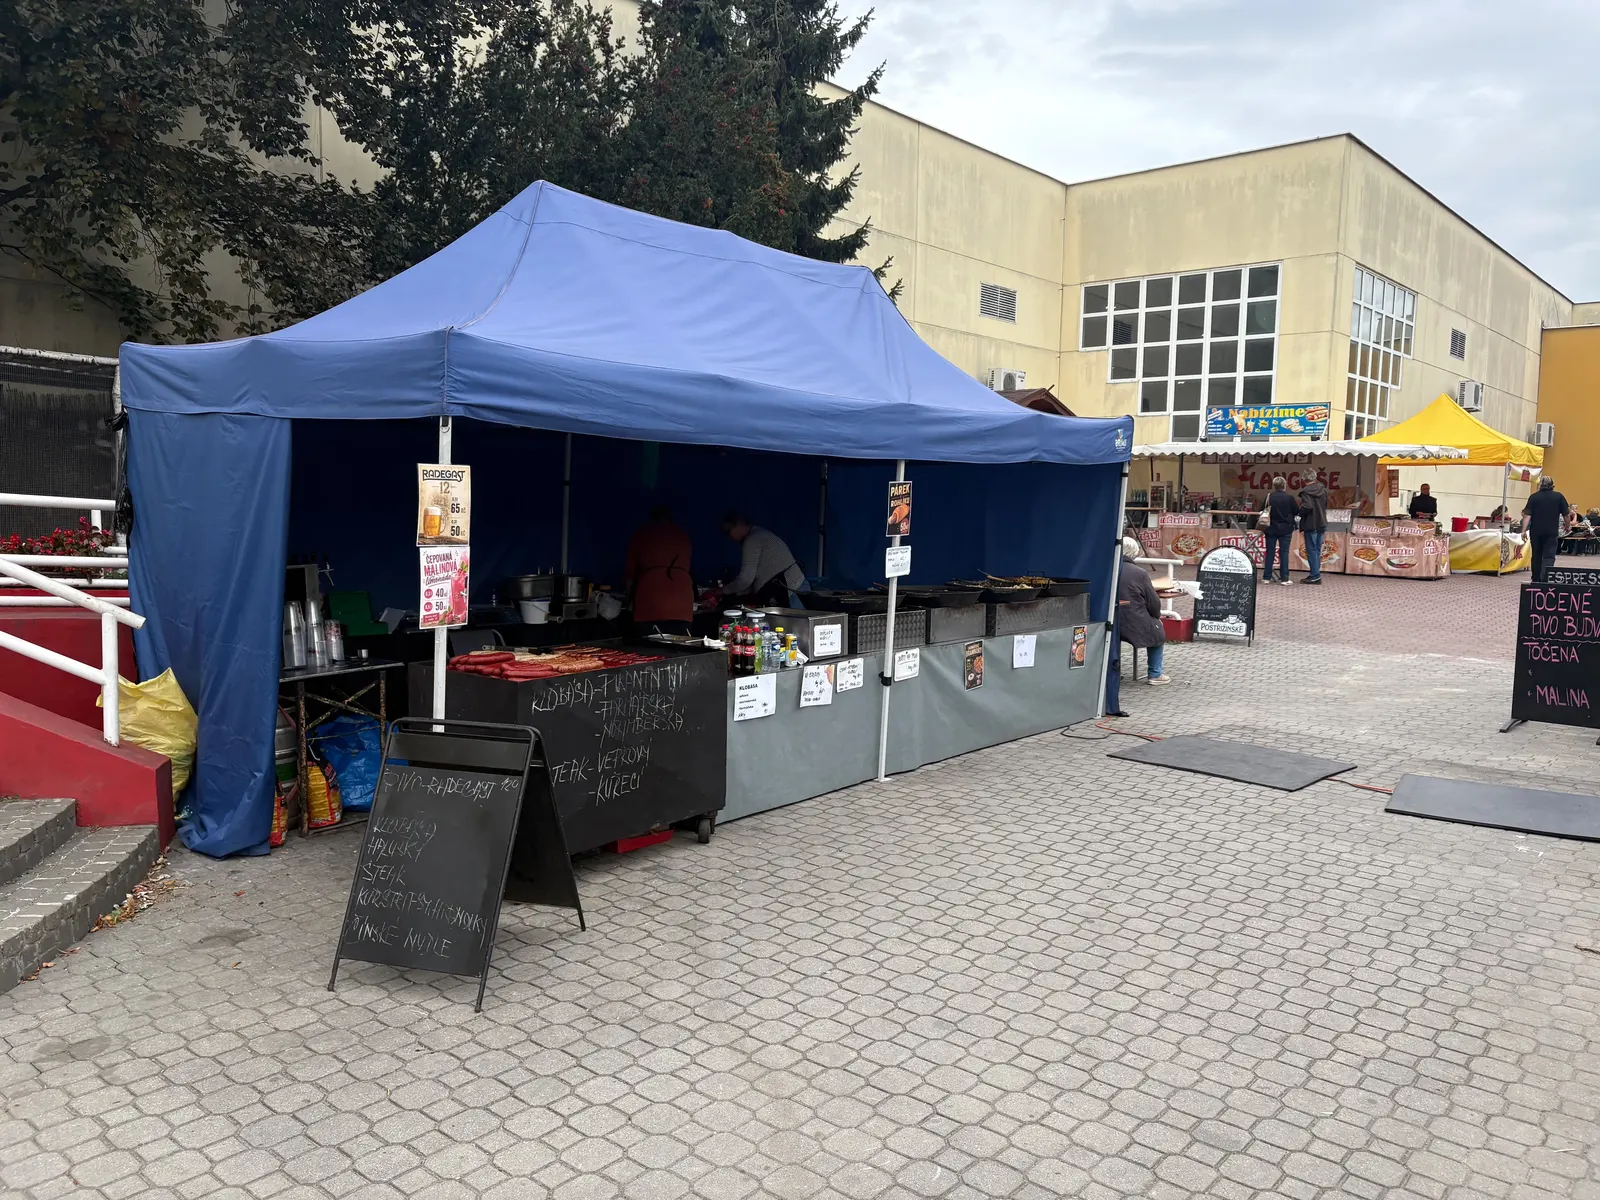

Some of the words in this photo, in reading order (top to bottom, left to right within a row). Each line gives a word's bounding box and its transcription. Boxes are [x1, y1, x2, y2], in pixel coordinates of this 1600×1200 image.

[1229, 406, 1305, 419] Nabízíme
[422, 469, 466, 483] RADEGAST
[1249, 467, 1341, 490] LAGŠE
[439, 481, 450, 494] 12
[890, 483, 910, 497] PÁREK
[450, 502, 460, 514] 65
[450, 525, 460, 536] 50
[1140, 530, 1160, 541] OČENÉ
[425, 550, 453, 565] ČEPOVANÁ
[424, 559, 458, 577] MALINOVÁ
[1547, 571, 1600, 585] ESPRES
[435, 588, 444, 598] 40
[435, 601, 444, 611] 50
[1525, 587, 1593, 614] TOČENÉ
[1529, 614, 1559, 636] PIVO
[1563, 615, 1600, 638] BUDV
[1522, 642, 1582, 664] TOČENÁ
[1535, 684, 1590, 709] MALINA
